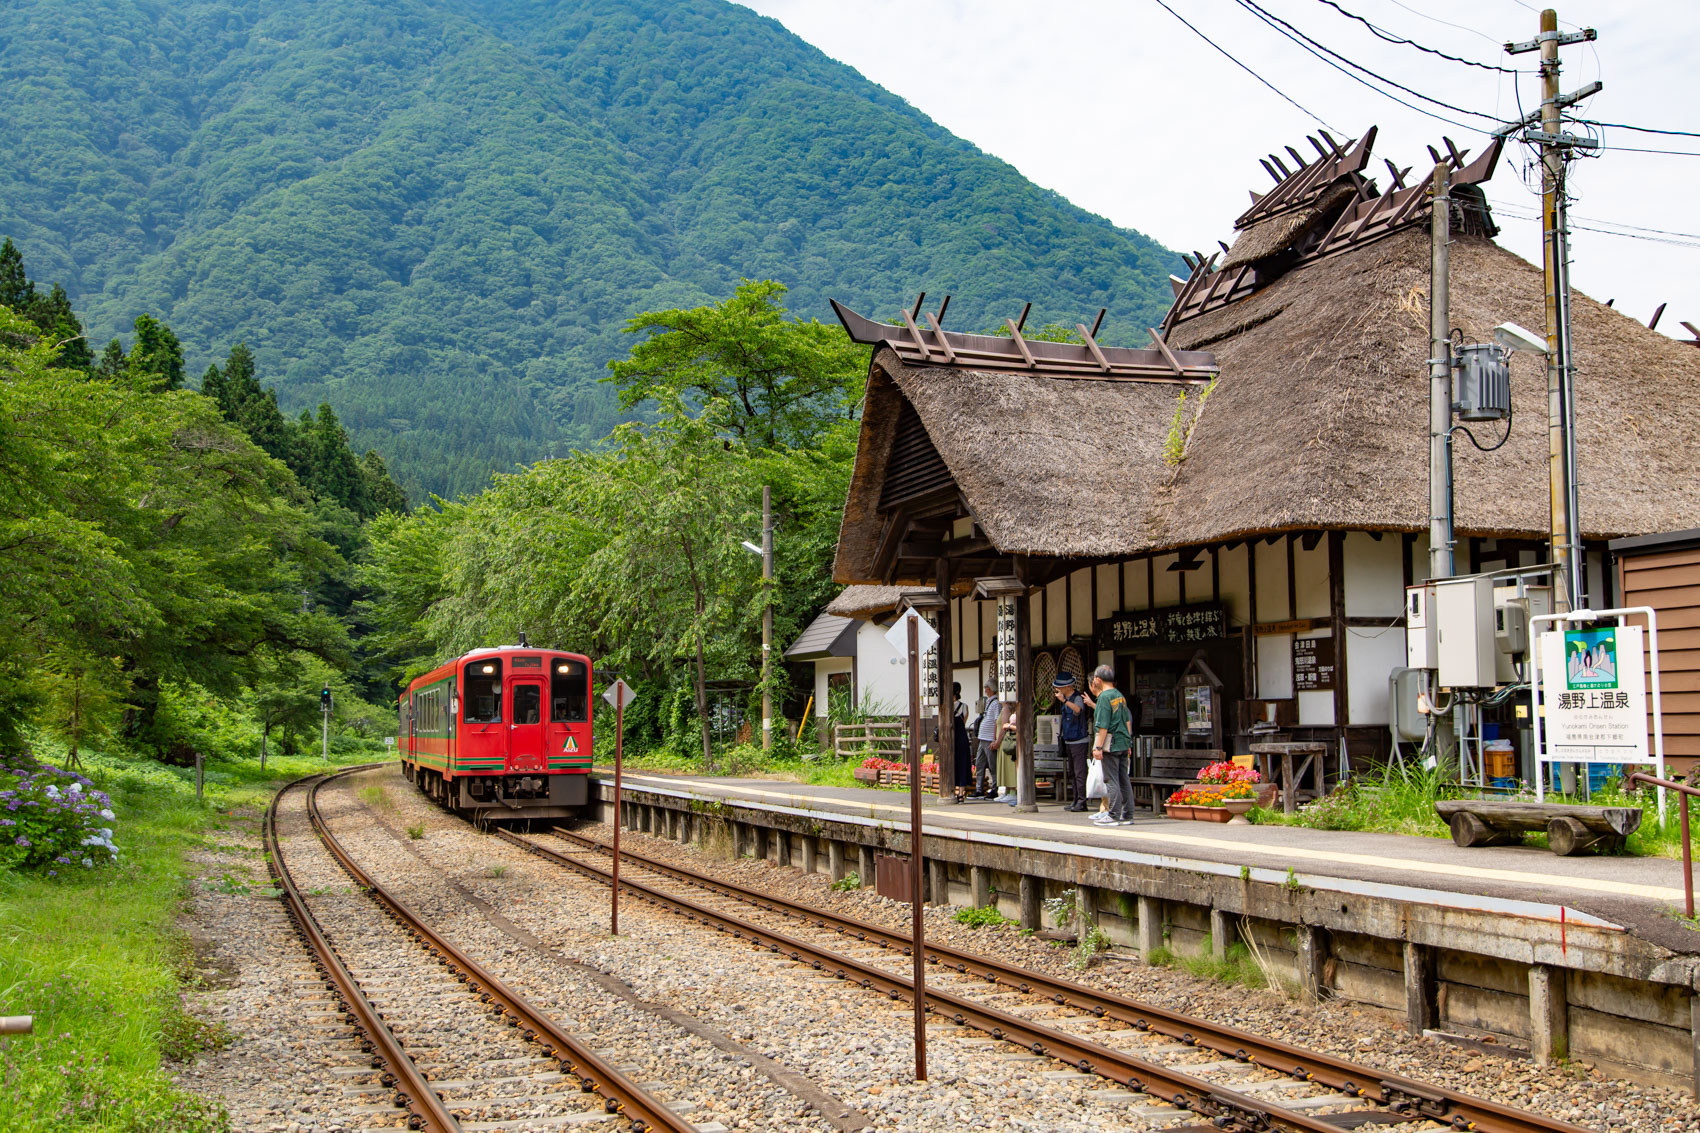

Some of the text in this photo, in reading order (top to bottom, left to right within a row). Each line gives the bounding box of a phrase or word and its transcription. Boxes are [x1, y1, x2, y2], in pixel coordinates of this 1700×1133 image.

[1005, 604, 1016, 692] 湯野上温泉駅
[1113, 617, 1159, 641] 湯野上温泉
[927, 618, 939, 697] 湯上温泉駅
[1558, 691, 1630, 710] 湯野上温泉
